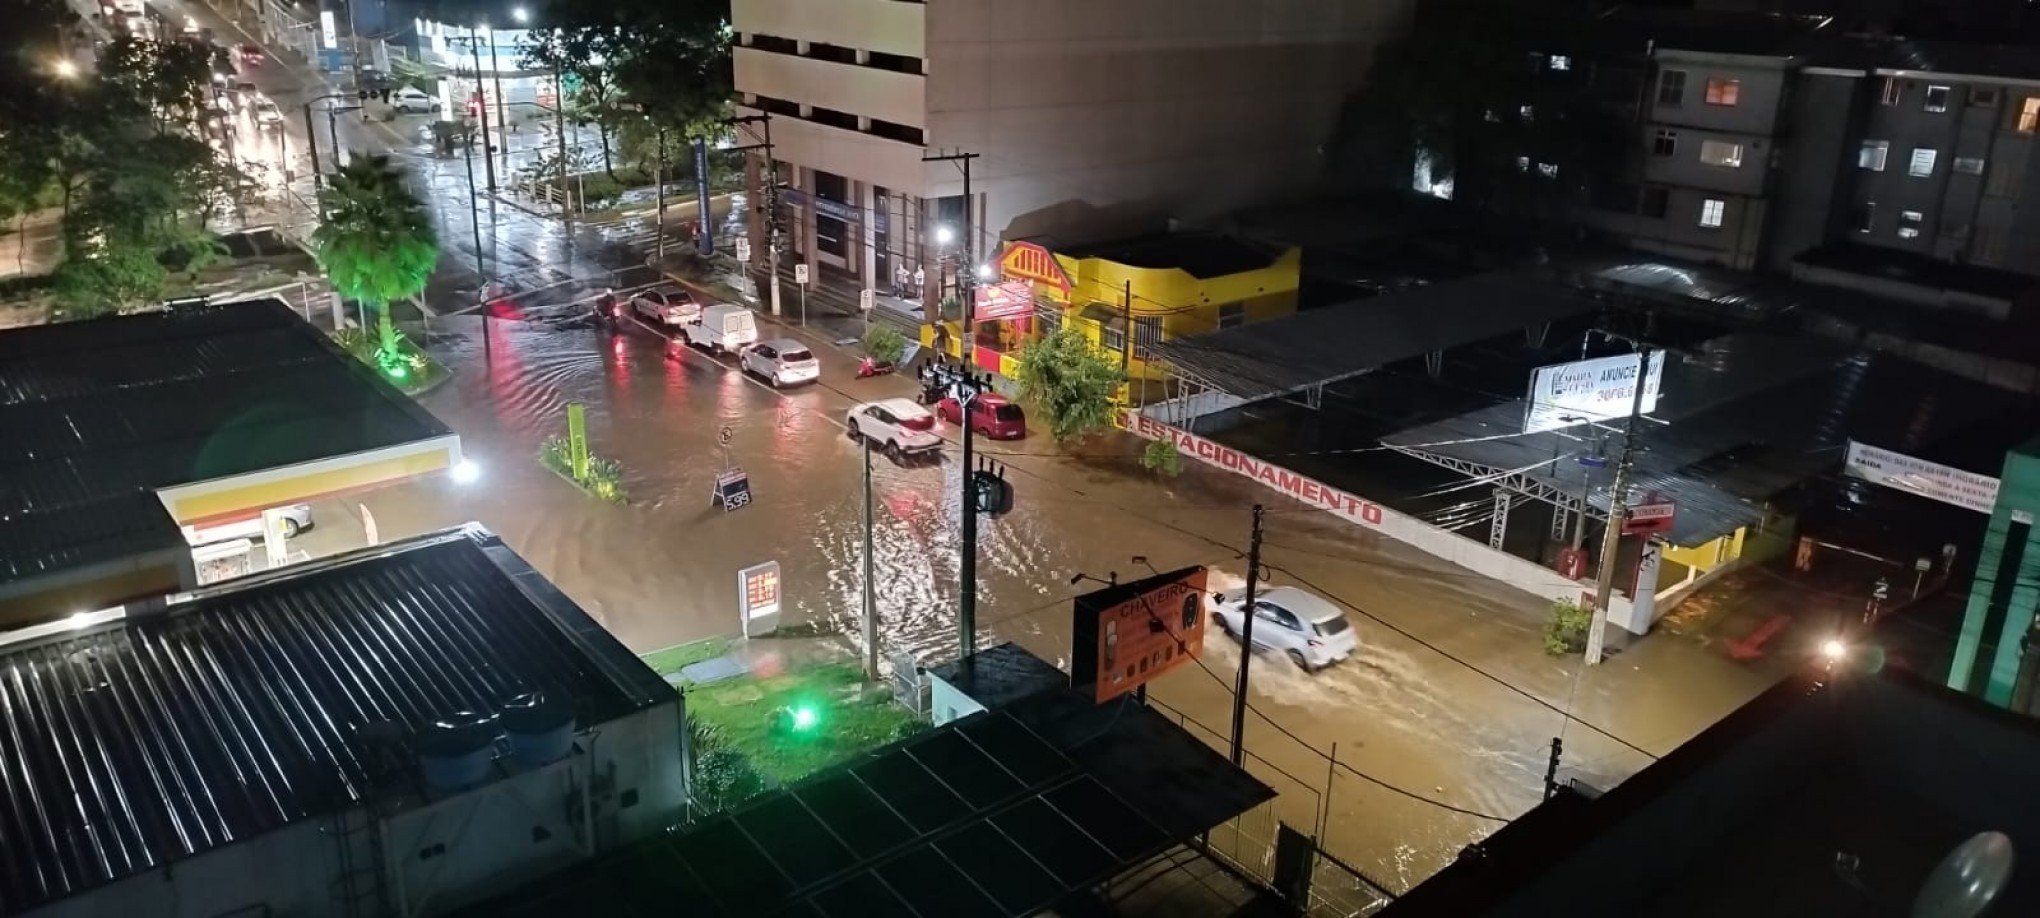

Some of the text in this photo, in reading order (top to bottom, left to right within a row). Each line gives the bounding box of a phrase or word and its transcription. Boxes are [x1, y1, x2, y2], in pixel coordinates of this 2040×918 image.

[1600, 365, 1638, 382] ANUNCIE
[1139, 416, 1383, 525] ESTACIONAMENTO
[1119, 581, 1188, 618] CHAVEIRO
